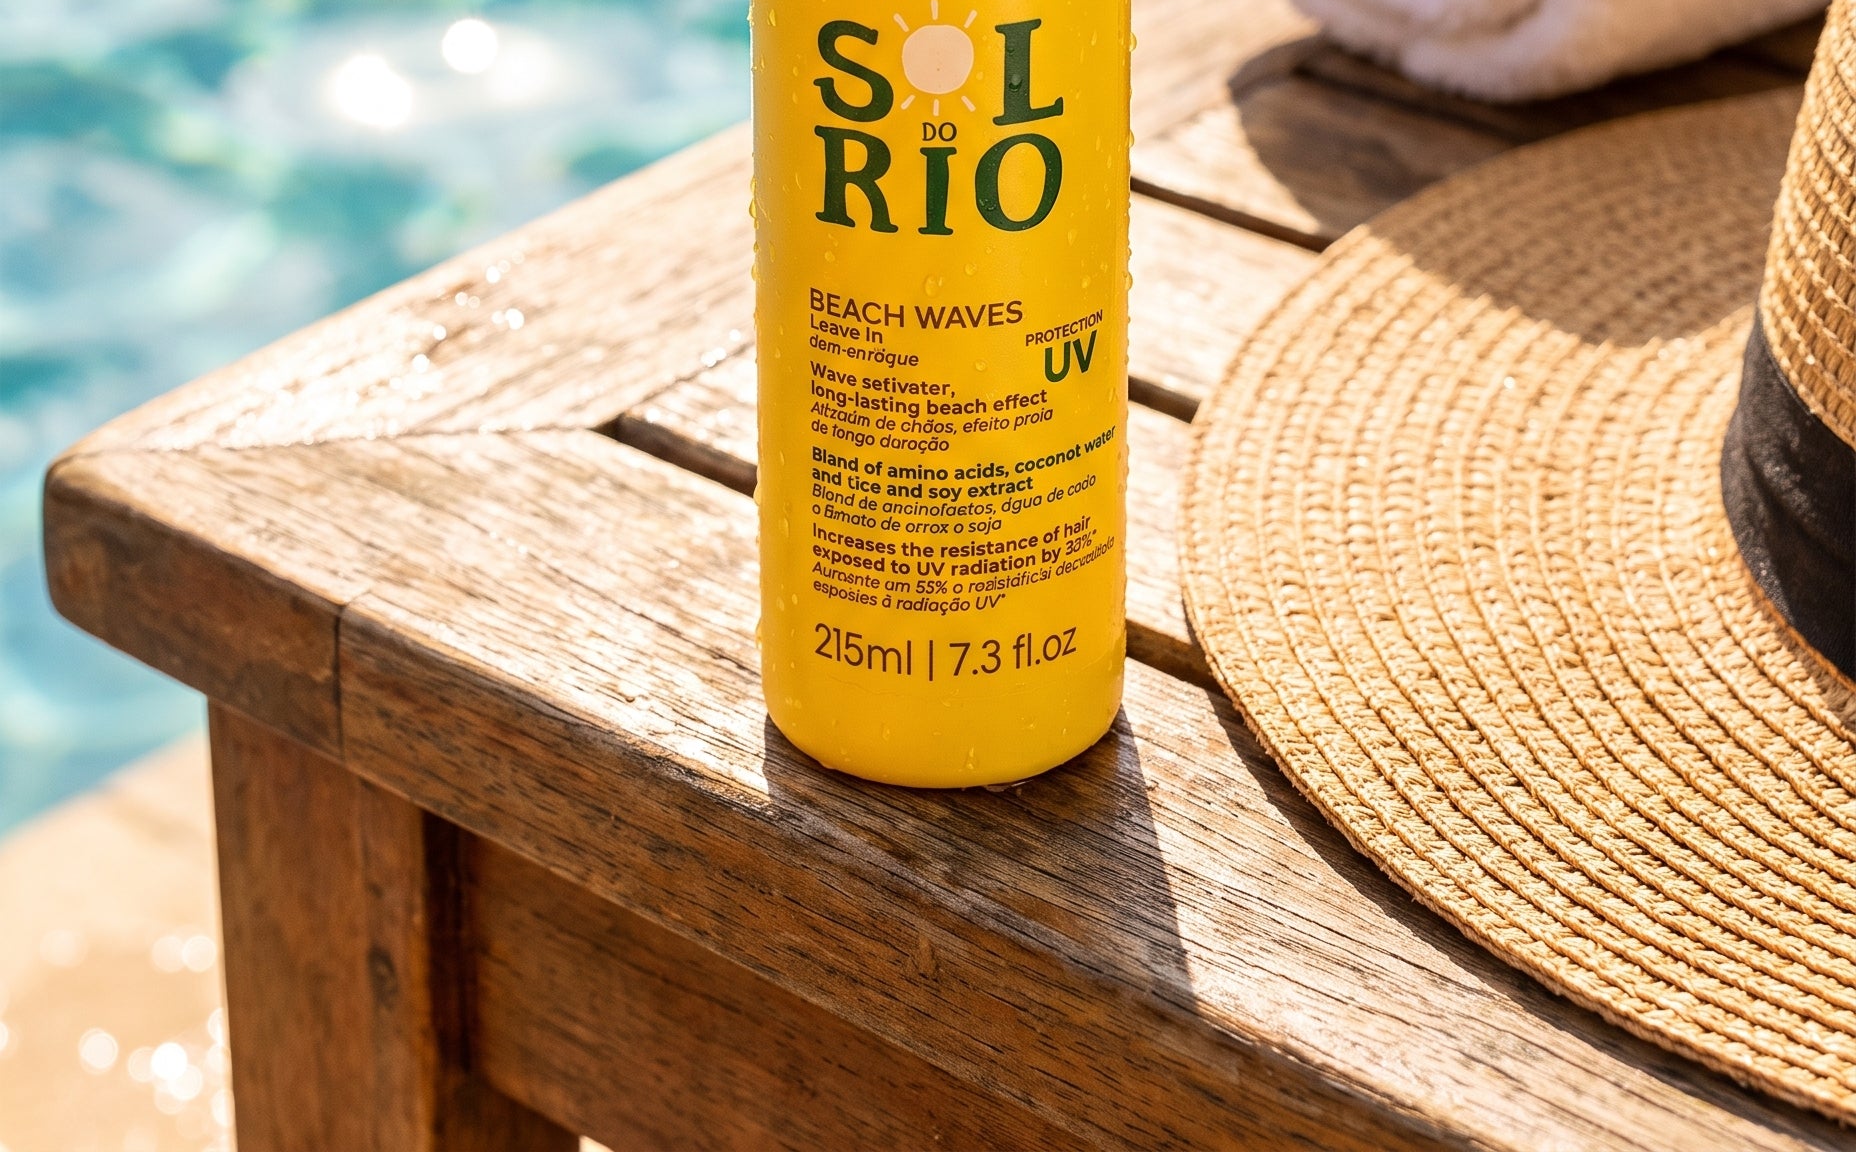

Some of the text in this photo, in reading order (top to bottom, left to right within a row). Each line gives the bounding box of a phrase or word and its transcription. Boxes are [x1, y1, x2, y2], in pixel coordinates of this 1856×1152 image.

[922, 122, 957, 142] DO
[814, 125, 1063, 236] RIO
[809, 287, 1023, 330] BEACH WAVES
[810, 313, 883, 344] Leave In
[1025, 309, 1103, 346] PROTECTION
[1044, 329, 1098, 383] UV
[810, 360, 857, 387] Wave
[811, 380, 1047, 418] long-lasting beach effect
[811, 419, 828, 435] de
[875, 415, 896, 431] de
[963, 416, 1010, 433] efeito
[812, 446, 859, 473] Bland
[864, 461, 883, 476] of
[887, 464, 948, 480] amino
[954, 463, 1010, 480] acids,
[1084, 425, 1116, 454] water
[812, 467, 842, 486] and
[887, 484, 922, 498] and
[928, 487, 962, 502] soy
[968, 476, 1034, 498] extract
[859, 496, 877, 511] de
[1046, 487, 1064, 503] de
[813, 515, 1091, 558] Increases the resistance of hair
[881, 516, 900, 531] de
[813, 544, 885, 572] exposed
[891, 560, 910, 575] to
[917, 561, 945, 576] UV
[951, 554, 1036, 576] radiation
[1042, 548, 1061, 564] by
[896, 597, 970, 615] radiação
[815, 622, 912, 675] 215ml
[949, 639, 1001, 677] 7.3
[1013, 626, 1077, 670] fl.oz
